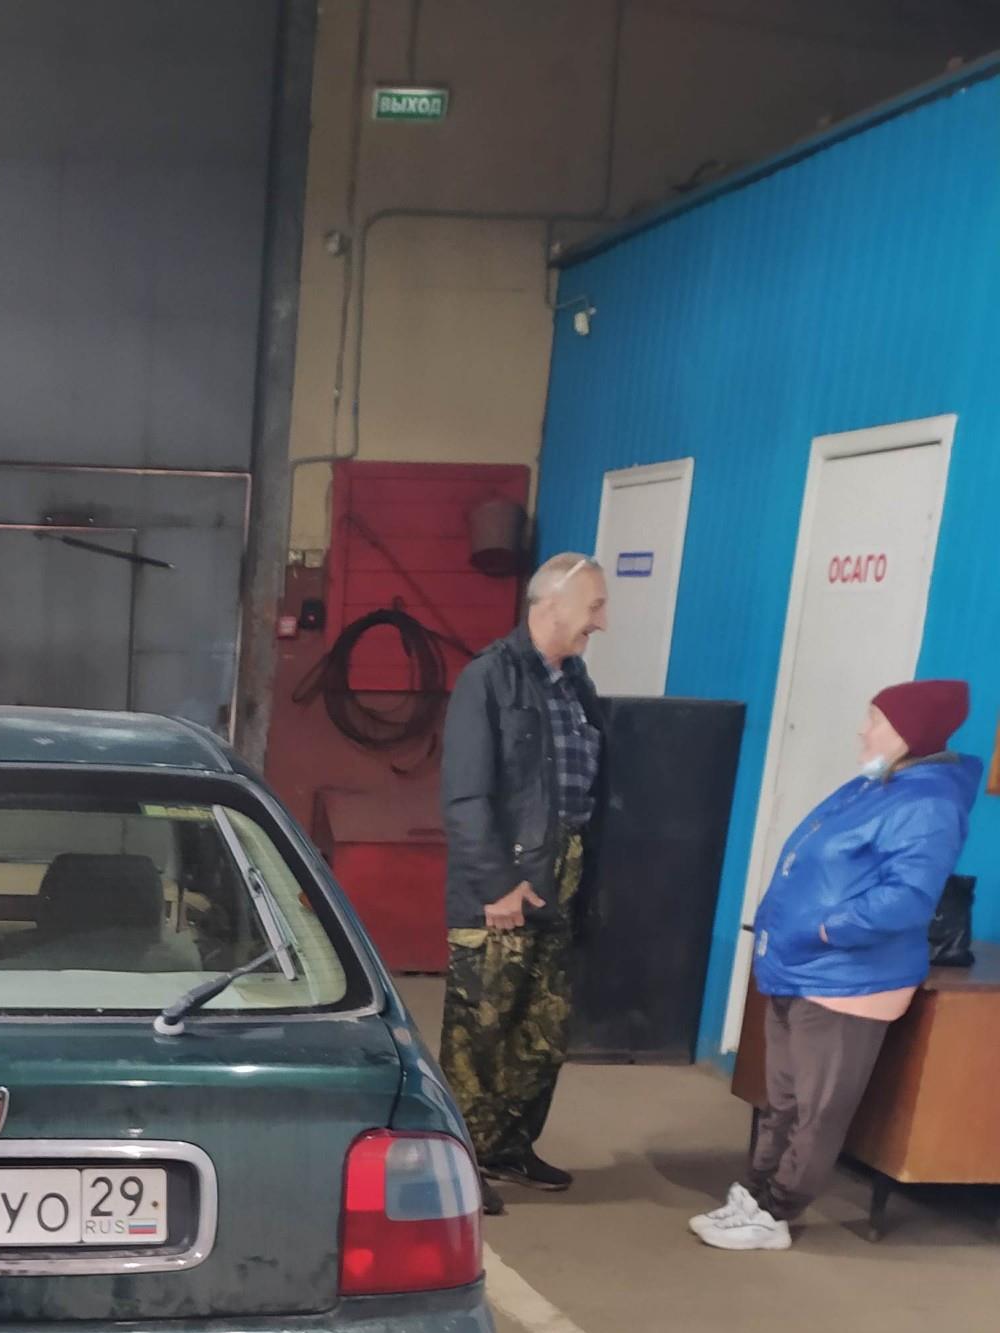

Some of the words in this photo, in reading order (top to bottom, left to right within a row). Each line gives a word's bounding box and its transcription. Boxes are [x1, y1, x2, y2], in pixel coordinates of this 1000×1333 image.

[380, 96, 442, 115] ВЫХОД
[828, 553, 887, 584] ОСАГО
[90, 1176, 144, 1217] 29
[85, 1219, 126, 1234] RUS
